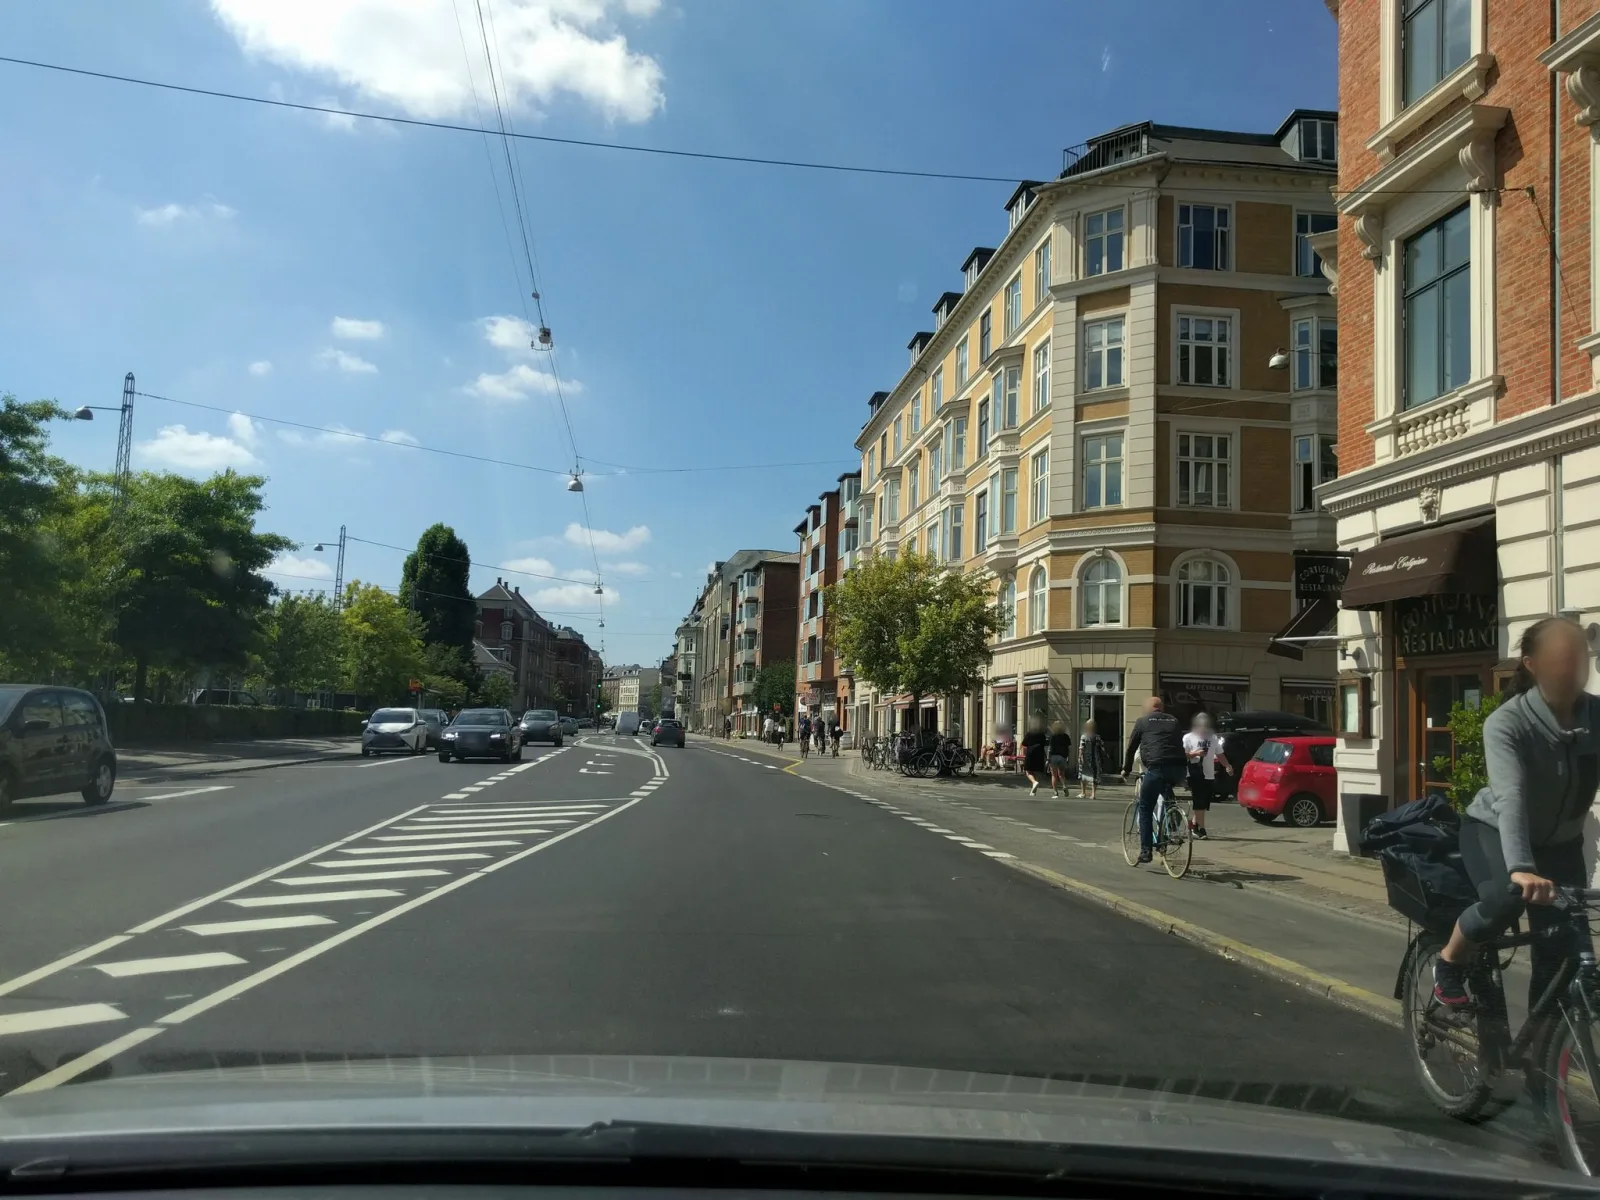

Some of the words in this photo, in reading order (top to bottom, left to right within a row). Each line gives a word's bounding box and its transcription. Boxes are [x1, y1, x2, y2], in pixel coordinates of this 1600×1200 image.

[1299, 564, 1345, 582] CORTIGIANO
[1300, 583, 1345, 592] RESTAURANT
[1402, 626, 1496, 654] RESTAURANT
[1080, 698, 1091, 706] 22
